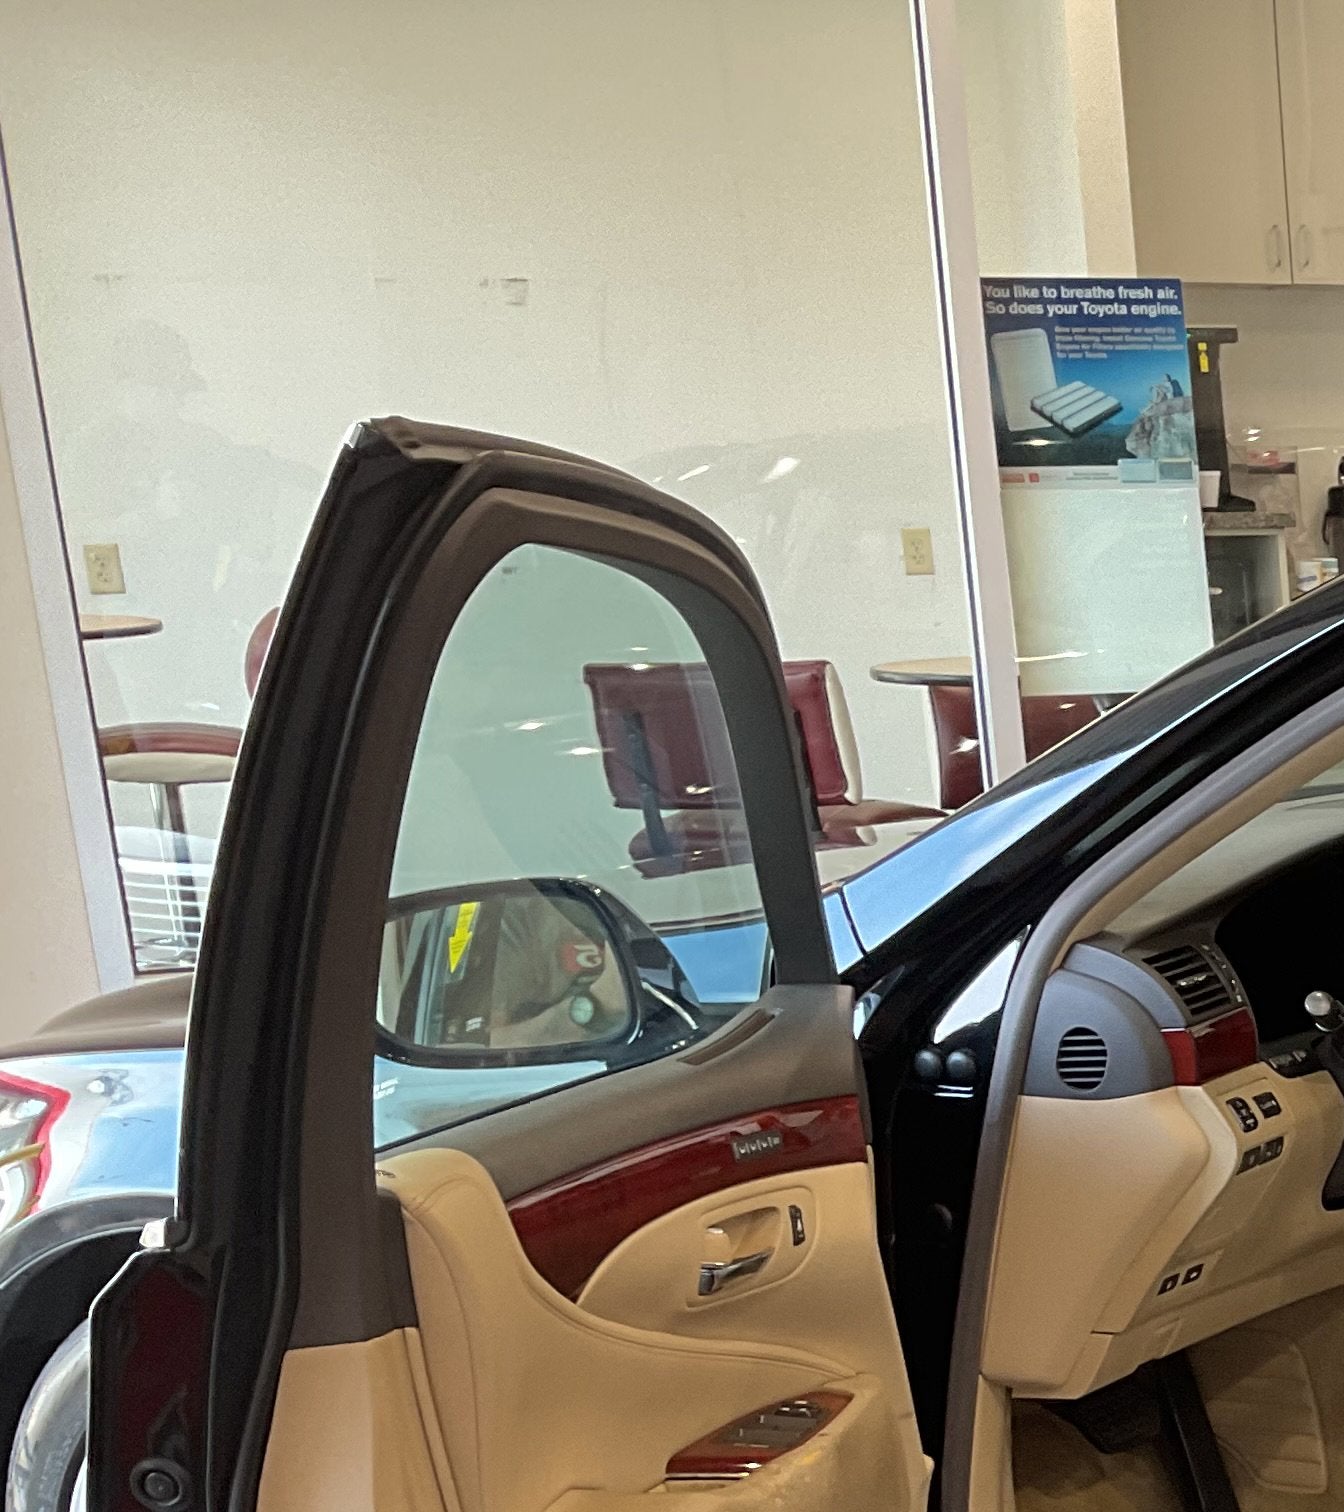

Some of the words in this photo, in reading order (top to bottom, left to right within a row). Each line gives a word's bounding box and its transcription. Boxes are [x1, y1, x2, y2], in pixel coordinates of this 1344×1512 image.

[983, 285, 1009, 298] You
[1013, 285, 1039, 298] like
[1042, 287, 1056, 298] to
[1061, 286, 1115, 299] breathe
[1118, 286, 1153, 299] fresh
[1157, 286, 1178, 299] air.
[986, 302, 1005, 314] So
[1009, 301, 1044, 314] does
[1047, 303, 1078, 317] your
[1080, 302, 1127, 317] Toyota
[1130, 302, 1182, 318] engine.
